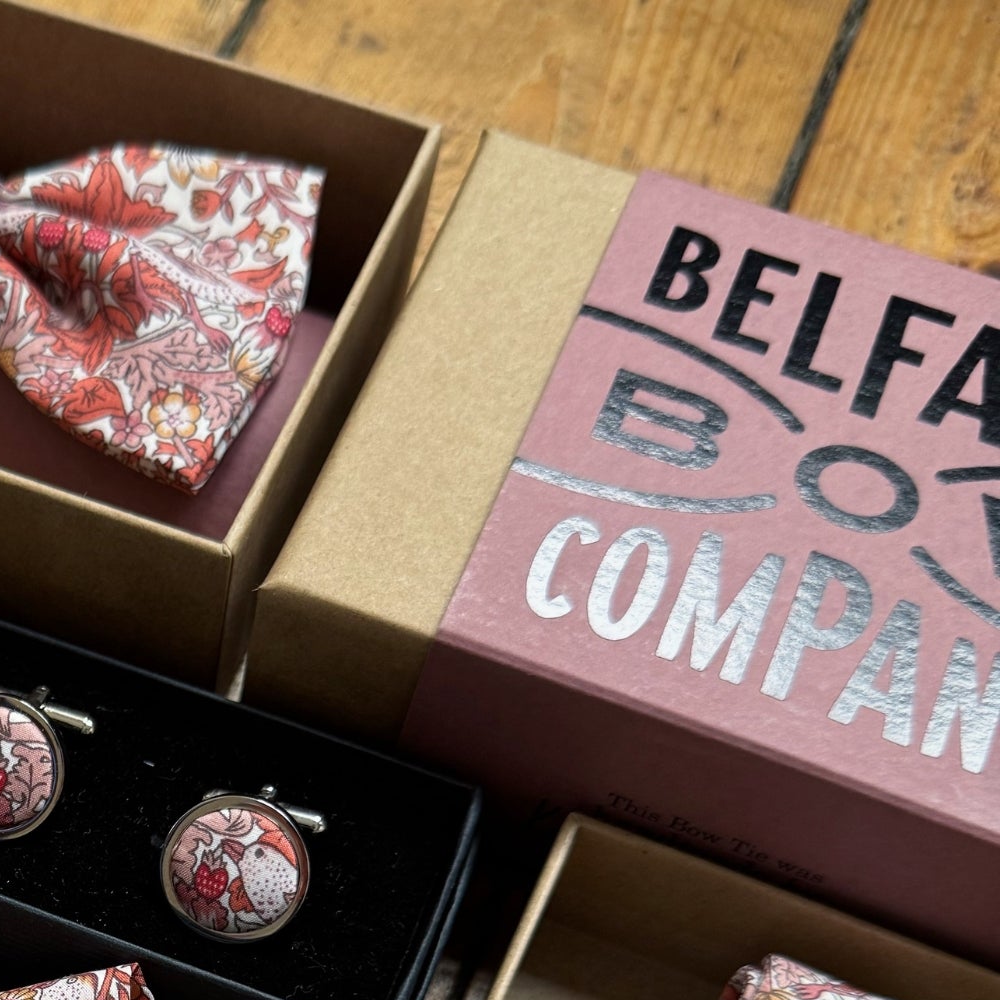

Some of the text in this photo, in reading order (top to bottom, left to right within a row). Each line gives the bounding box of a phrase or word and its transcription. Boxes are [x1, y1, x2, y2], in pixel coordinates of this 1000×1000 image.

[642, 225, 1000, 445] BELFA
[590, 368, 1000, 578] BO
[524, 516, 1000, 774] COMPAN
[607, 792, 825, 885] This Bow Tie was
